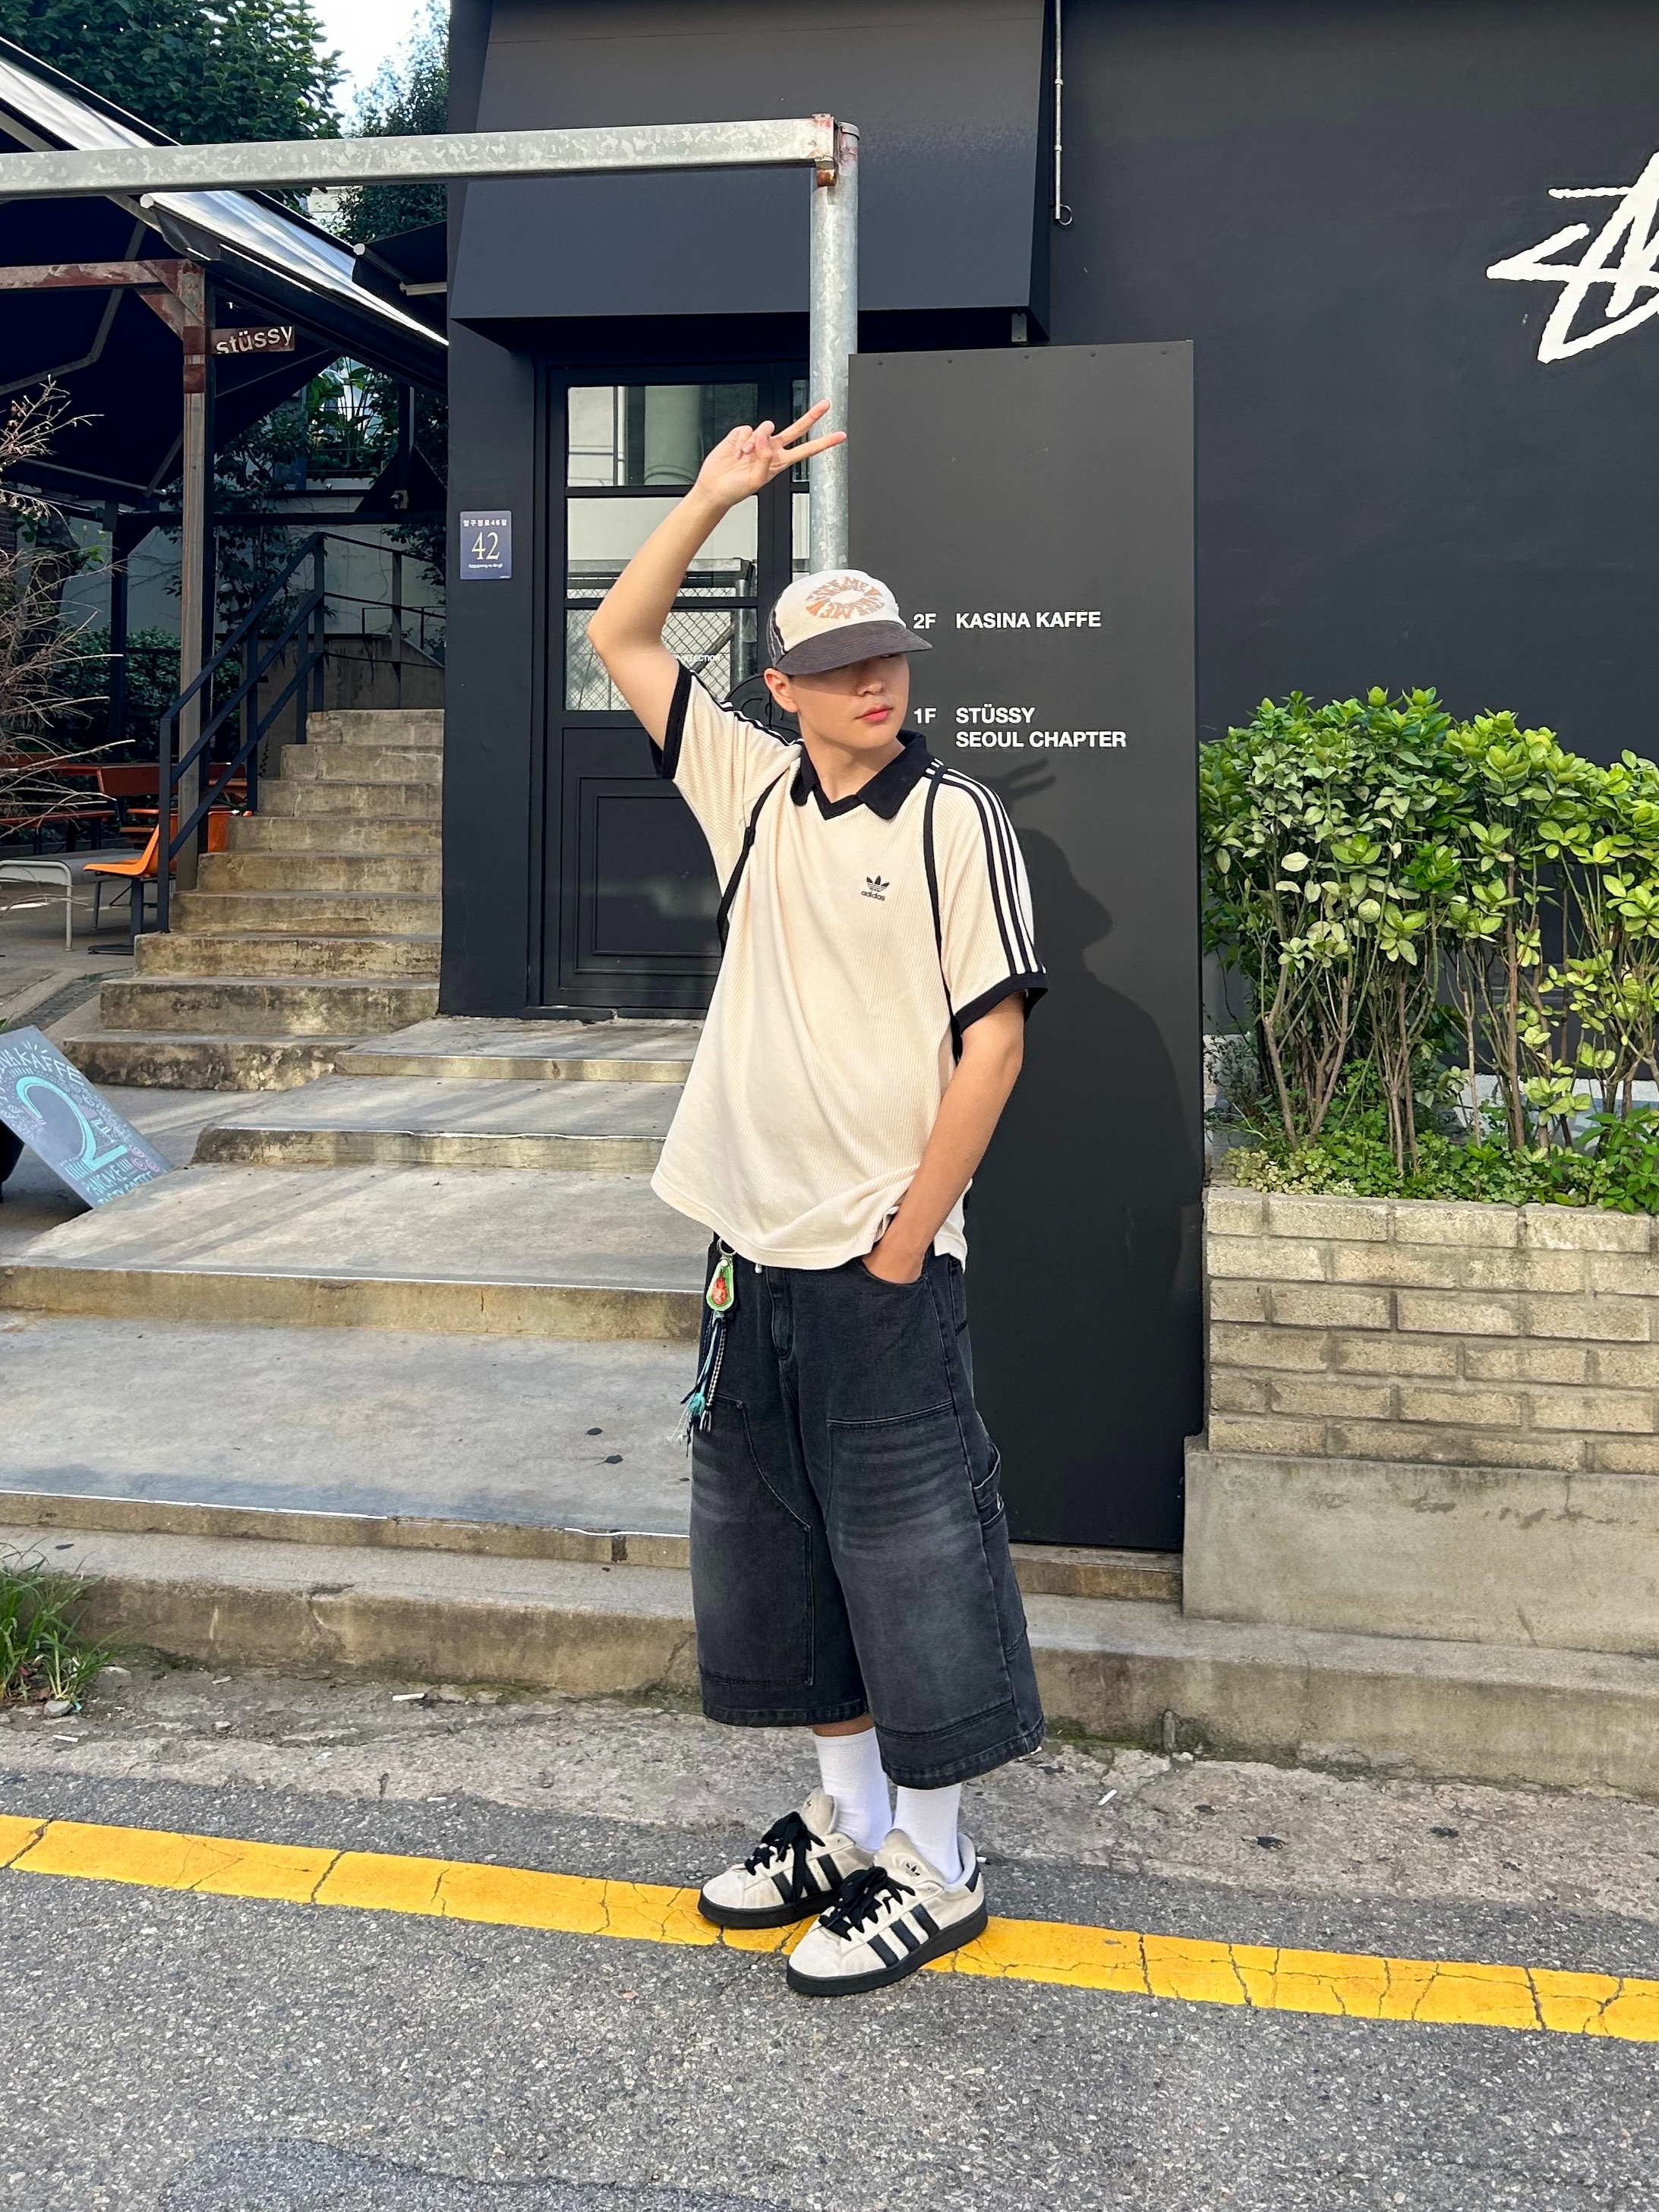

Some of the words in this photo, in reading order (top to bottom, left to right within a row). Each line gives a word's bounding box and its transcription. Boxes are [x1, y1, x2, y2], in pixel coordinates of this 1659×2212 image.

[216, 326, 292, 354] stüssy
[472, 531, 501, 560] 42
[913, 613, 937, 629] 2F
[955, 612, 1031, 629] KASINA
[1035, 610, 1102, 628] KAFFE
[913, 707, 937, 724] 1F
[954, 703, 1036, 723] STÜSSY
[954, 730, 1024, 748] SEOUL
[1028, 730, 1127, 748] CHAPTER
[861, 890, 886, 902] adidas
[13, 1047, 85, 1087] KAFFE
